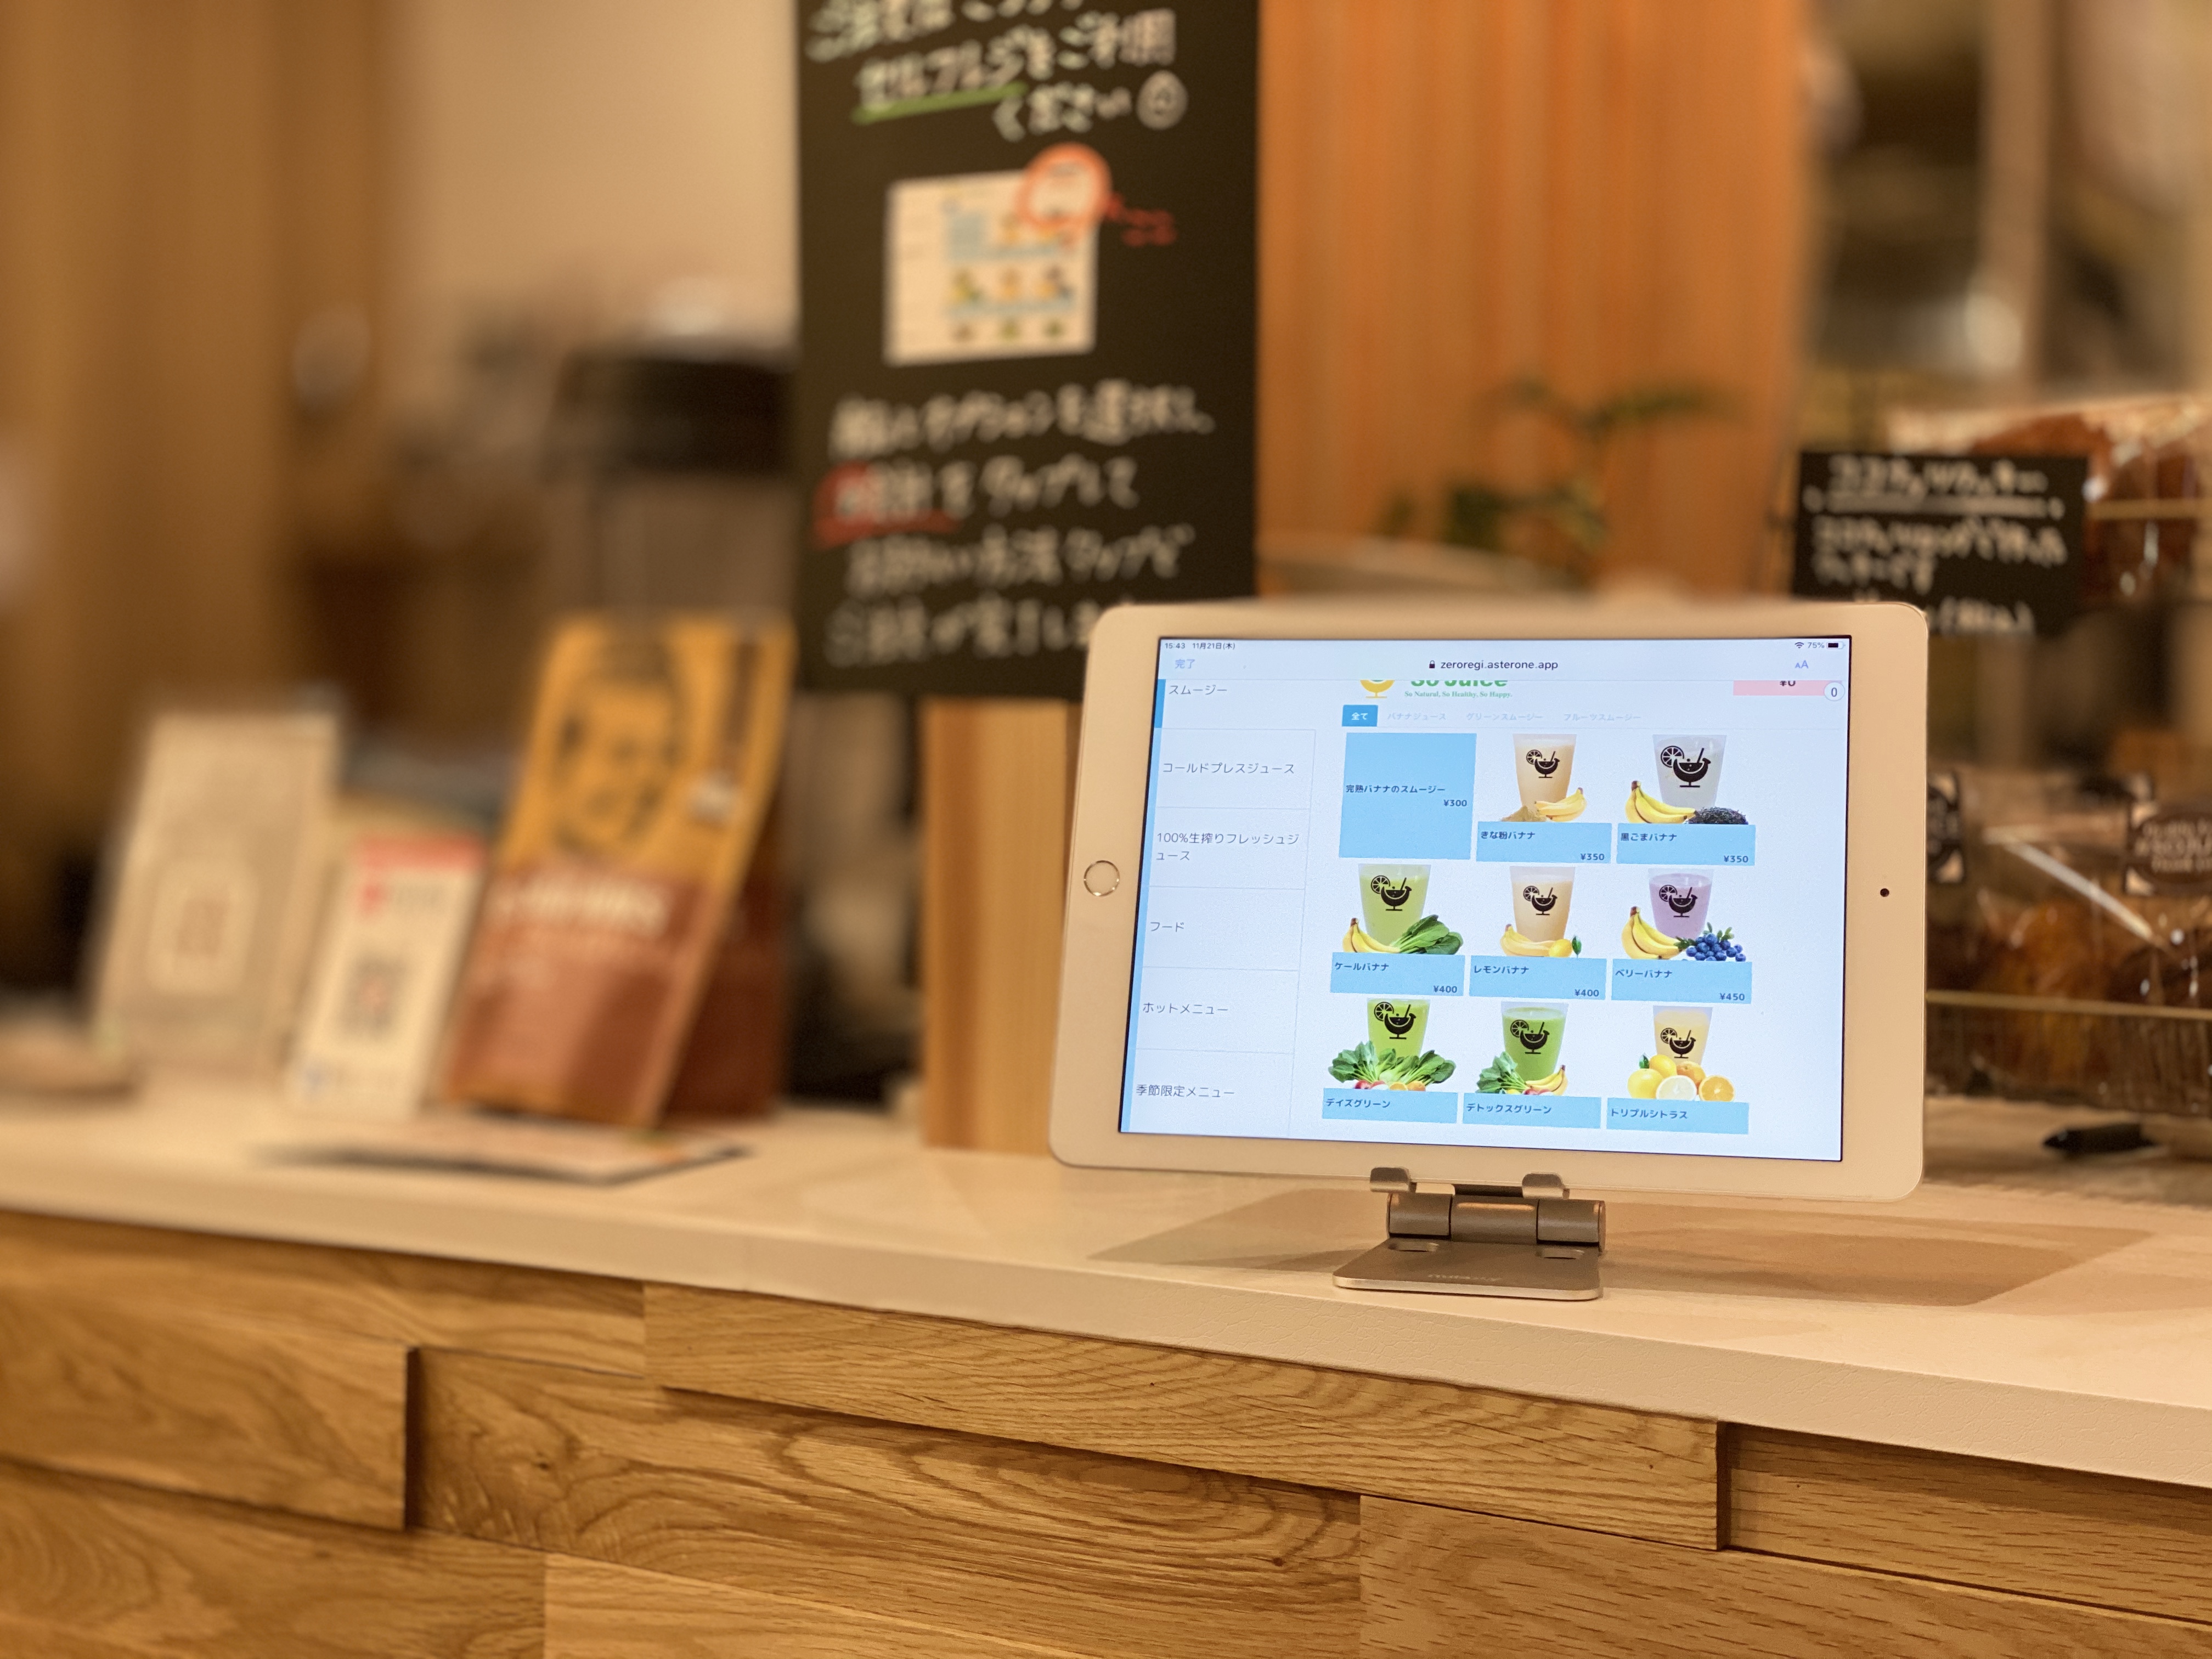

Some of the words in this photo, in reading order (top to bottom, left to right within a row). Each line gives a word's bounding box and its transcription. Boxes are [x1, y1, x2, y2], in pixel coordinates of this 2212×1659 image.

[1192, 642, 1235, 650] 11月21日(木)
[1175, 658, 1195, 669] 完了
[1440, 660, 1559, 671] zeroregi.asterone.app
[1169, 684, 1228, 696] スムージー
[1831, 687, 1838, 697] 0
[1351, 712, 1368, 720] 全て
[1387, 712, 1447, 721] バナナジュース
[1466, 713, 1544, 721] グリーンスムージー
[1564, 713, 1641, 721] フルーツスムージー
[1162, 762, 1295, 775] コールドプレスジュース
[1346, 785, 1446, 793] 完熟バナナのスムージー
[1156, 832, 1300, 845] 100%生搾りフレッシュジ
[1481, 831, 1536, 840] きな粉バナナ
[1621, 833, 1677, 842] 黒ごまバナナ
[1155, 850, 1190, 861] ュース
[1150, 921, 1185, 933] フード
[1334, 962, 1389, 972] ケールバナナ
[1474, 965, 1530, 975] レモンバナナ
[1615, 969, 1673, 979] ベリーバナナ
[1433, 985, 1458, 994] ¥400
[1575, 989, 1600, 997] ¥400
[1719, 992, 1746, 1001] ¥450
[1142, 1002, 1228, 1015] ホットメニュー
[1136, 1084, 1235, 1098] 季節限定メニュー
[1325, 1098, 1391, 1109] デイズグリーン
[1466, 1103, 1552, 1114] デトックスグリーン
[1611, 1108, 1689, 1120] トリプルシトラス
